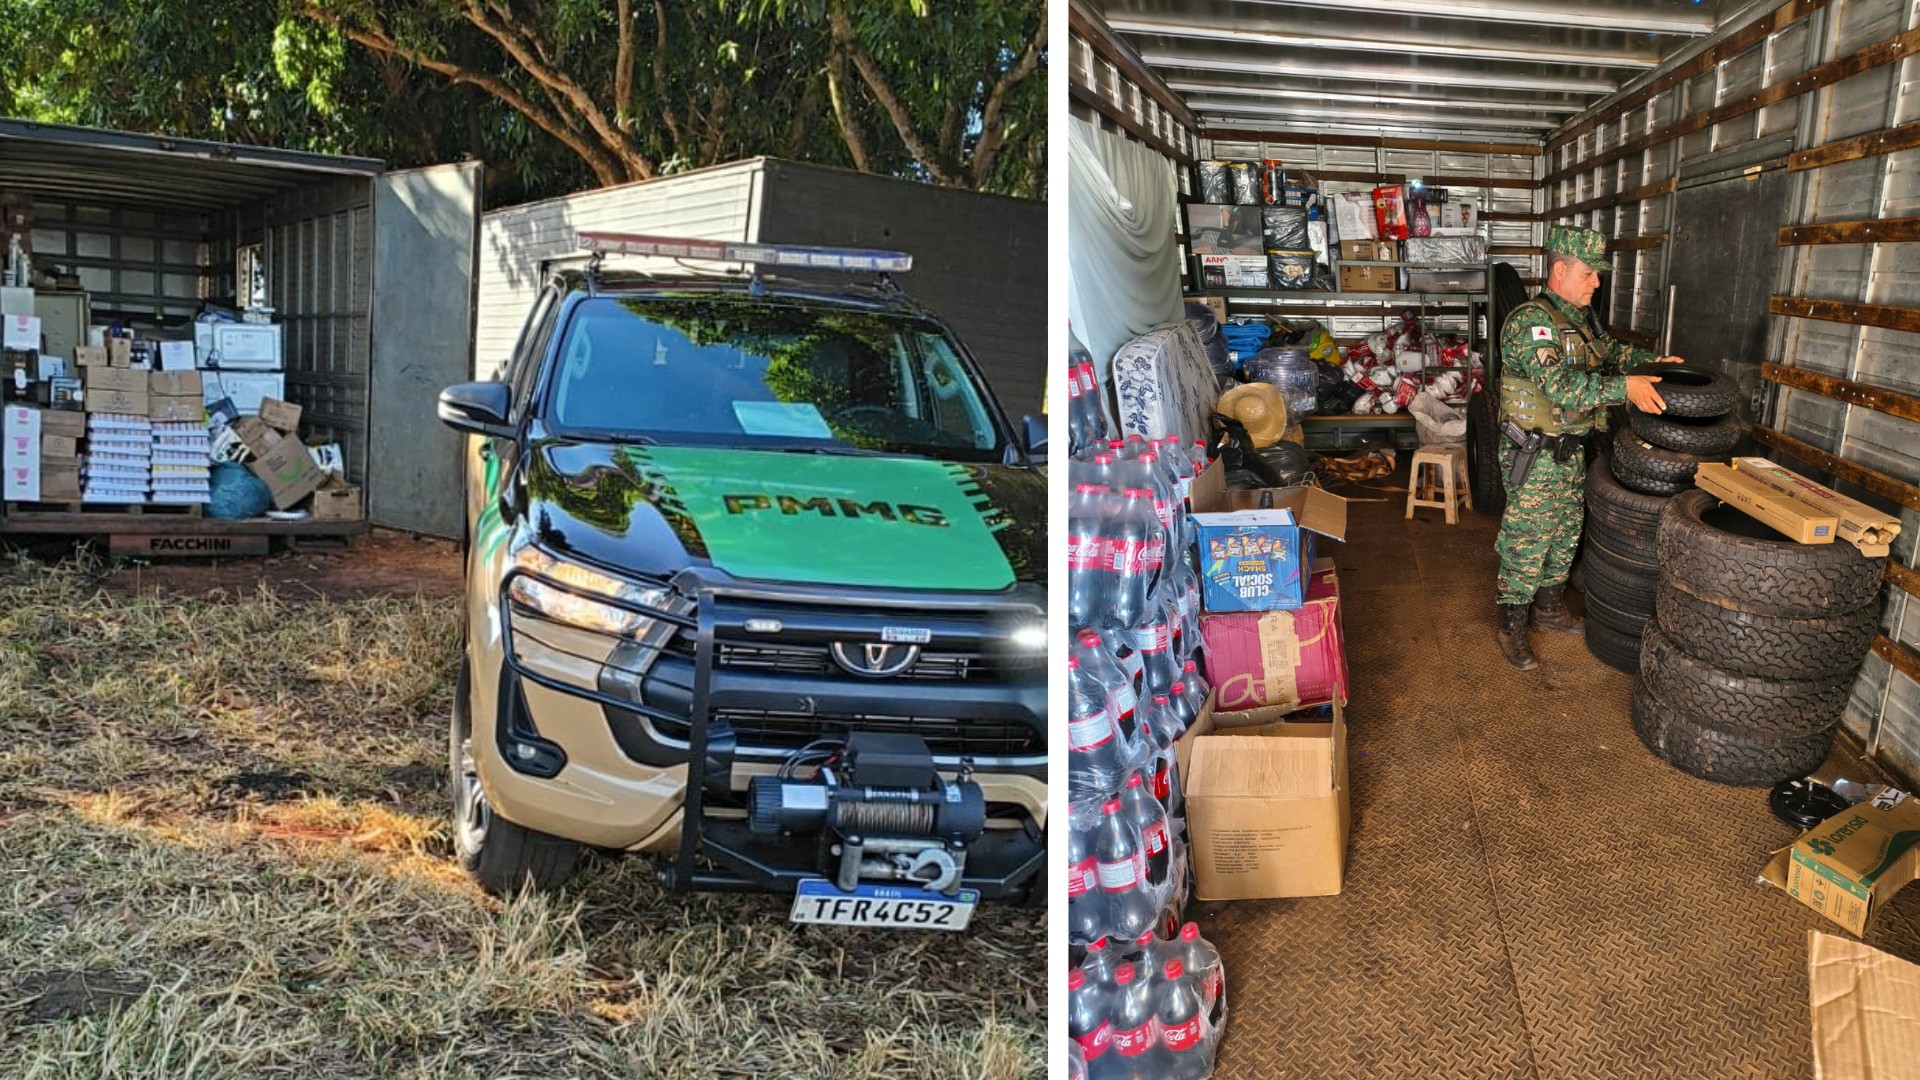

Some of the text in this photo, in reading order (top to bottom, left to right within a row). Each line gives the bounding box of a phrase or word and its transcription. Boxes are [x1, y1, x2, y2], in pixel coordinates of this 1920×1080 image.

[723, 495, 950, 527] PMMG
[151, 538, 231, 550] FACCHINI
[1240, 585, 1269, 598] CLUB
[815, 899, 954, 925] TFR4C52
